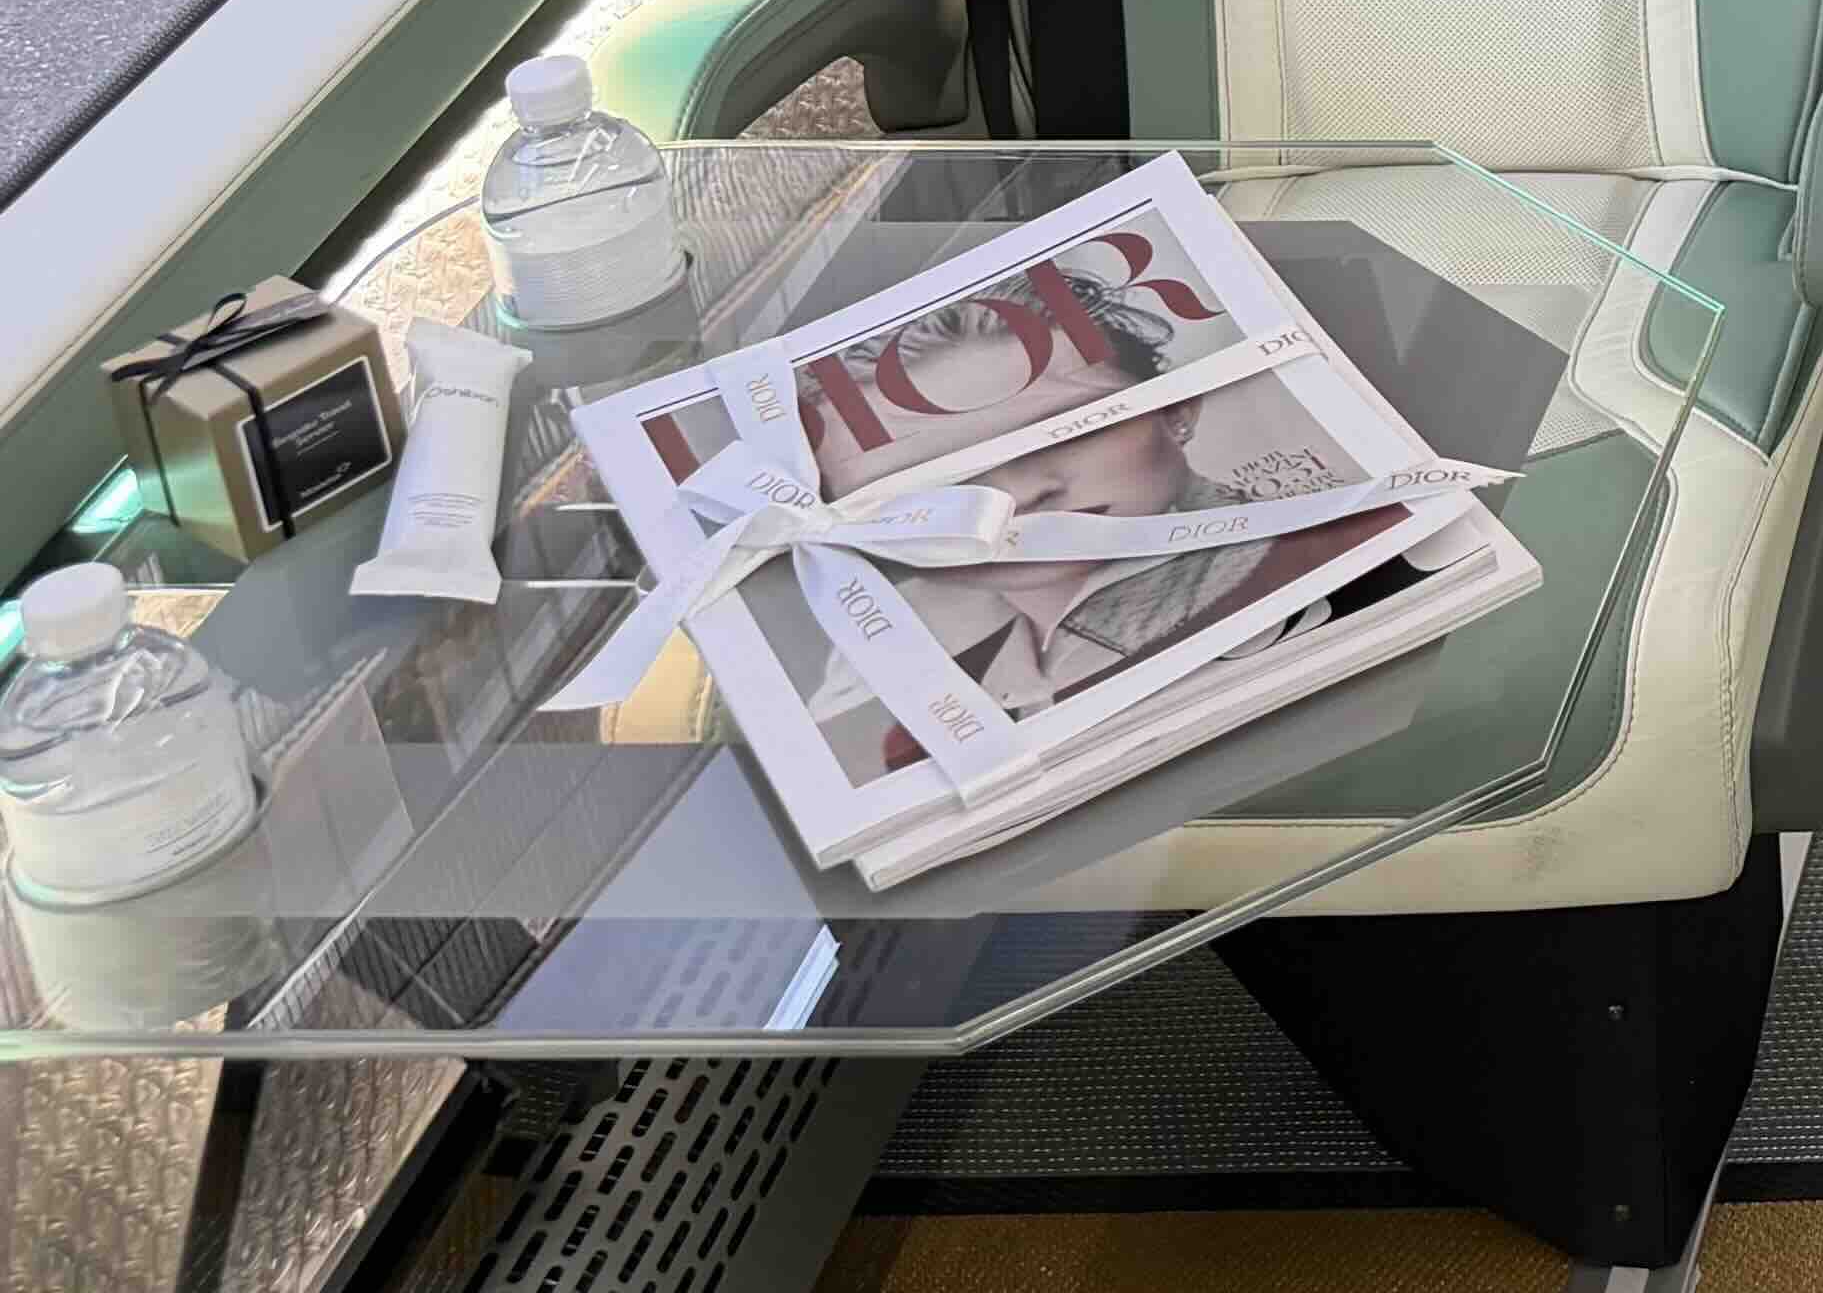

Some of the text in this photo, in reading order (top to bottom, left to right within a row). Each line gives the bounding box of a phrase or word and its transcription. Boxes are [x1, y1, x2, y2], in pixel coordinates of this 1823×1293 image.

[745, 373, 787, 424] DIOR
[1049, 401, 1132, 439] DIOR
[1390, 469, 1472, 490] DIOR
[1167, 516, 1250, 541] DIOR
[836, 576, 894, 641] DIOR
[928, 692, 986, 744] DIOR
